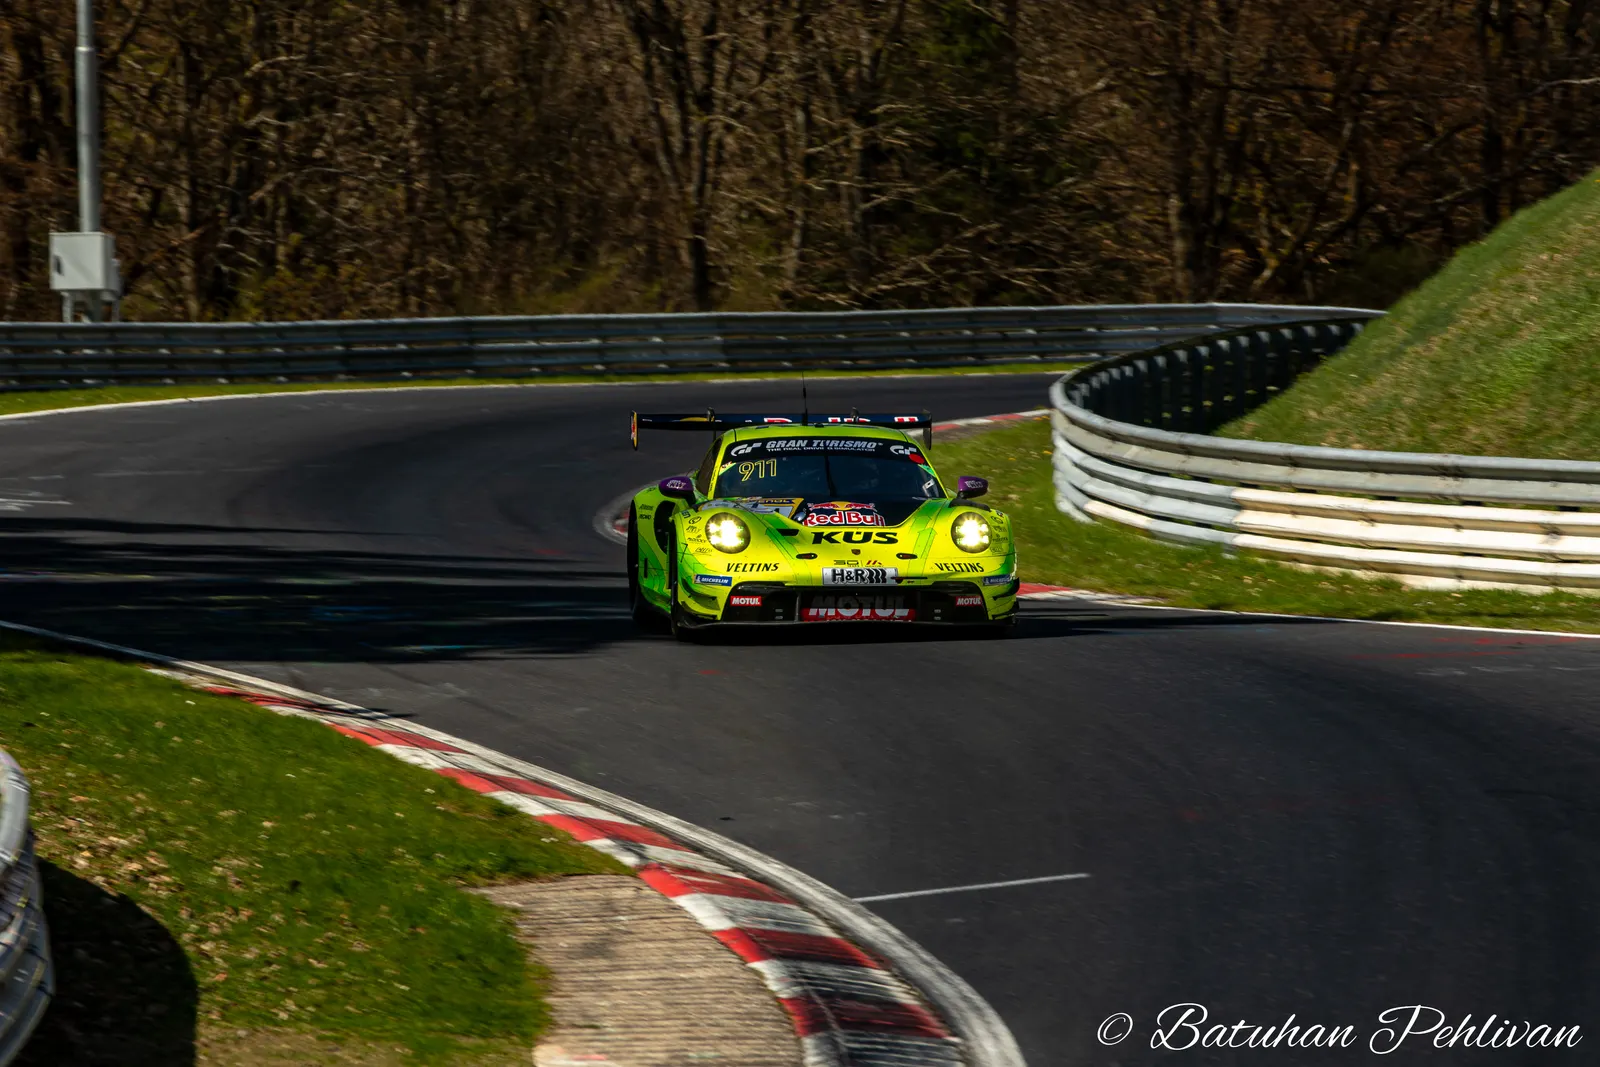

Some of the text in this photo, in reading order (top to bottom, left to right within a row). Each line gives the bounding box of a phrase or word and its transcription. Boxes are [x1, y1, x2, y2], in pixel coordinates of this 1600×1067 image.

[765, 439, 877, 449] GRAN TURISMO
[738, 458, 777, 482] 911
[802, 511, 886, 527] Red Bull
[811, 531, 899, 545] KÜS
[726, 562, 780, 573] VELTINS
[934, 562, 984, 573] VELTINS
[832, 568, 867, 584] H&R
[732, 597, 761, 605] MOTUL
[808, 595, 910, 617] MOTUL
[957, 596, 981, 605] MOTUL
